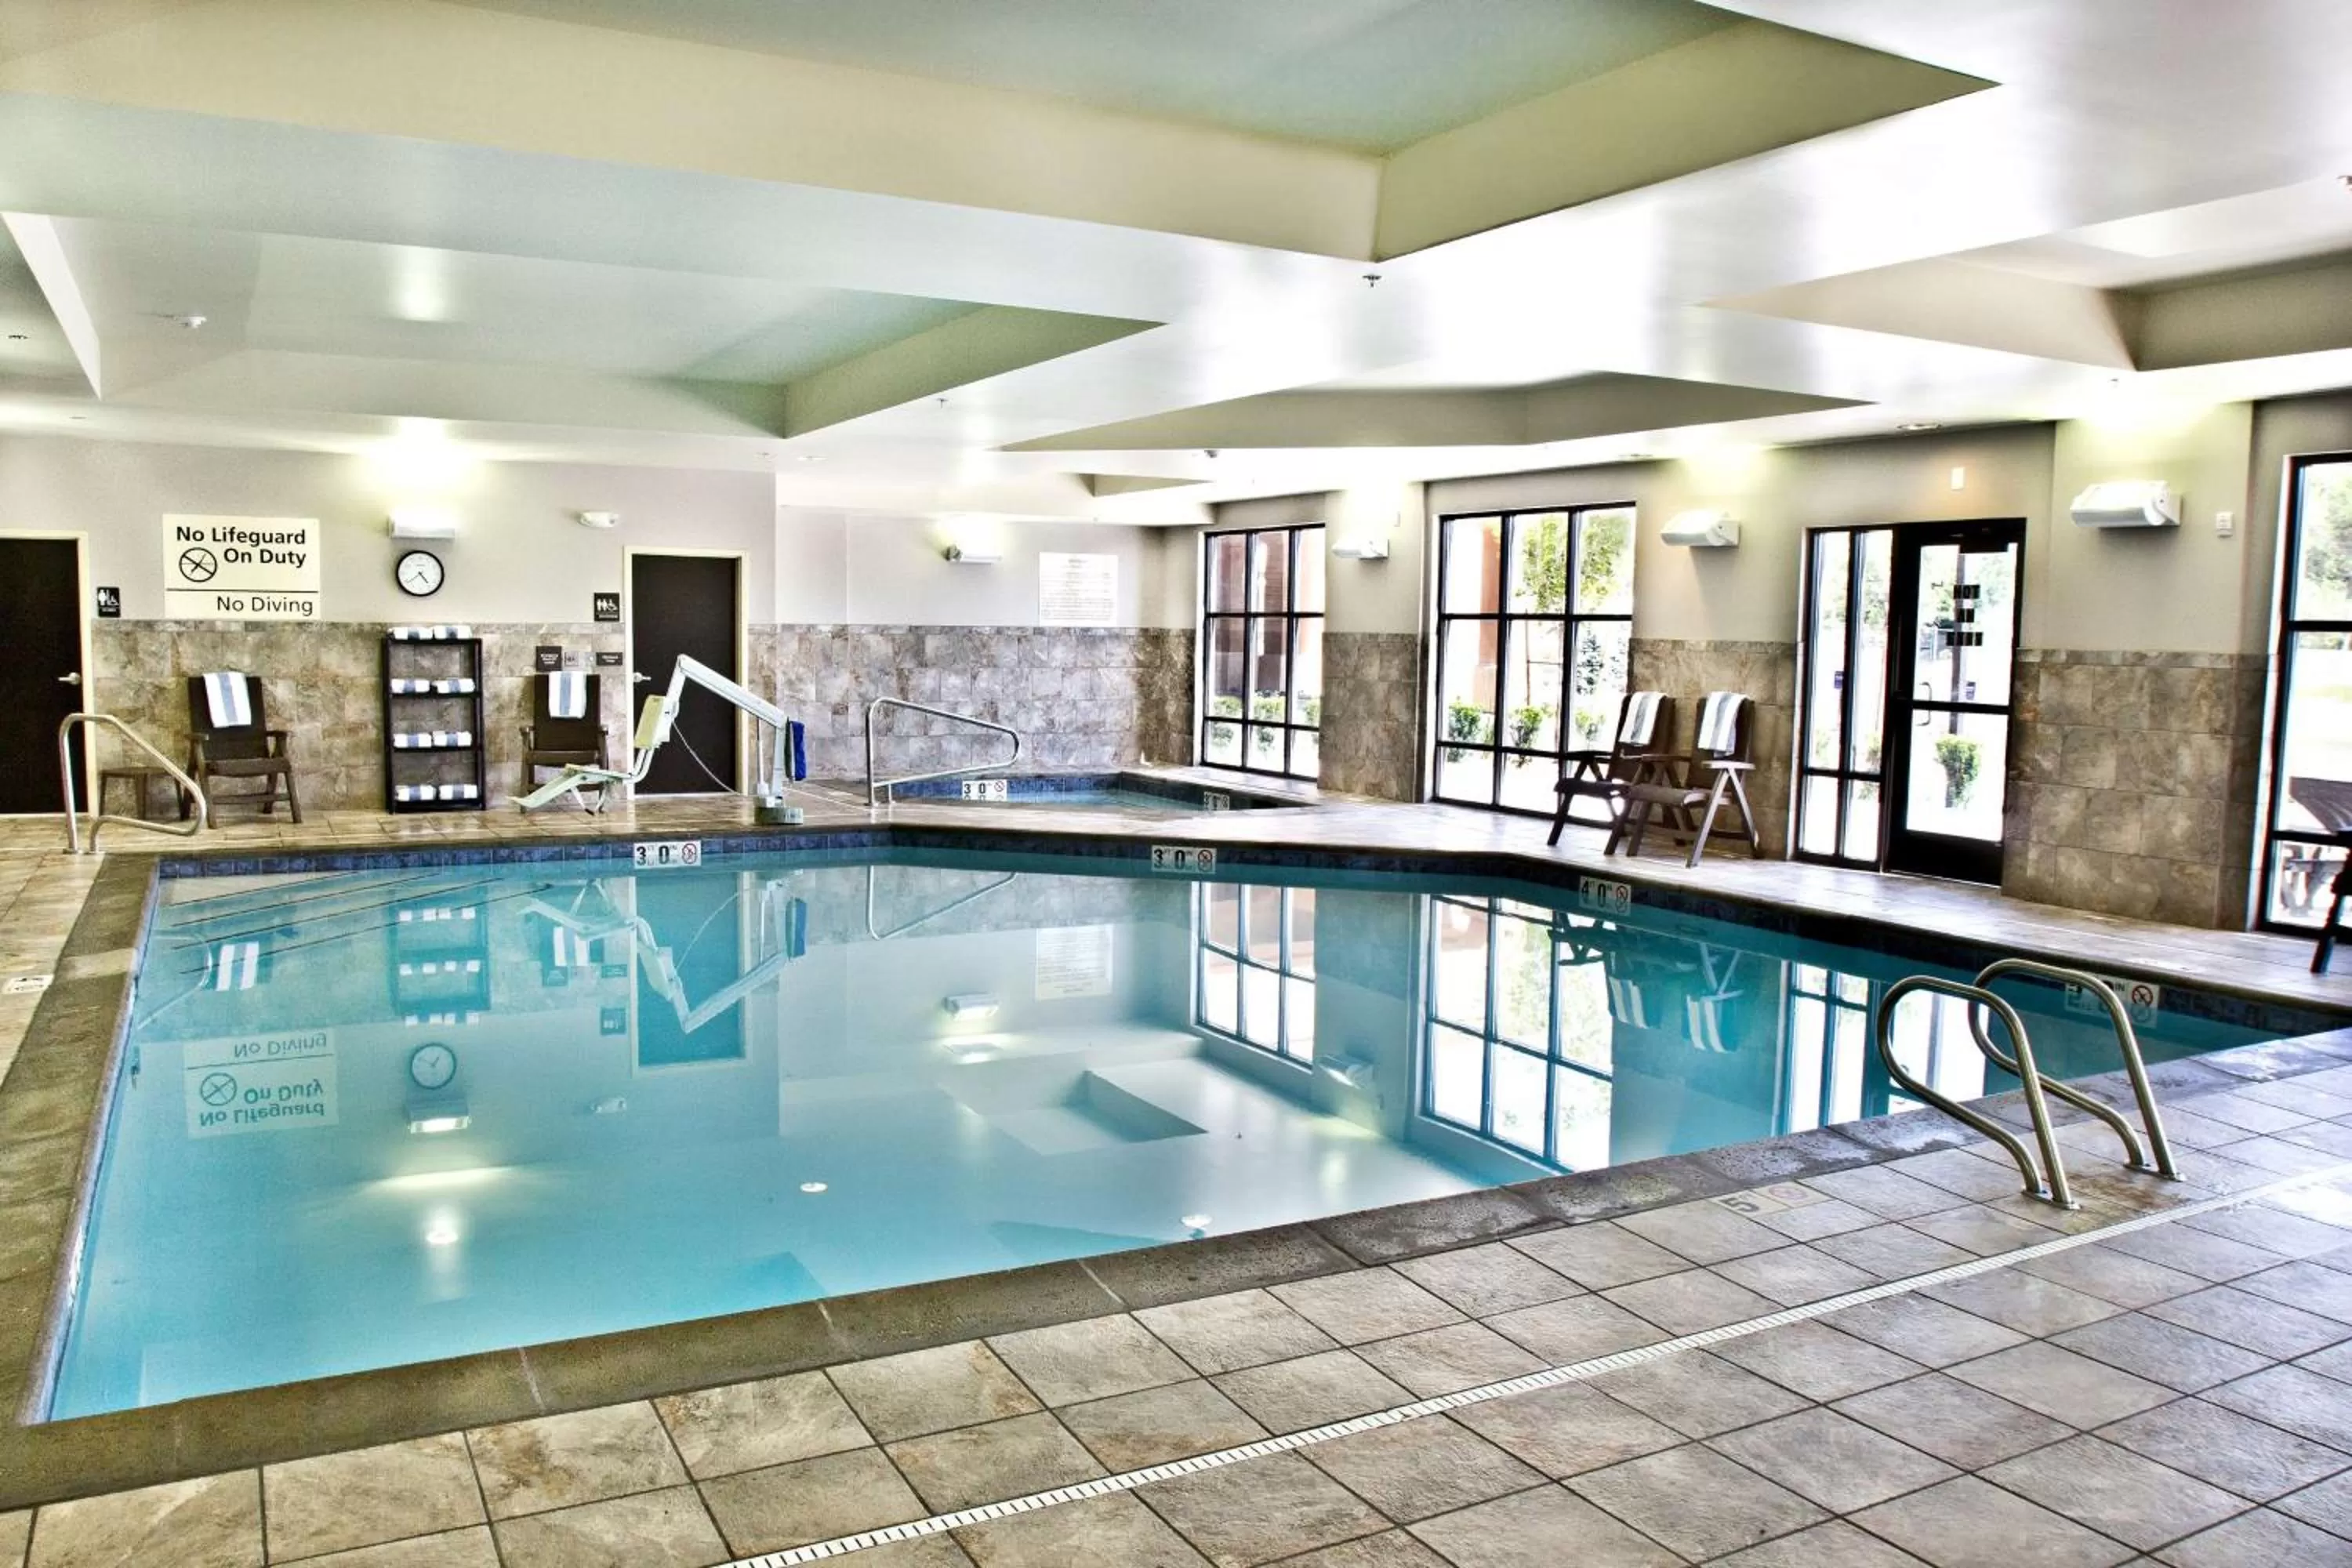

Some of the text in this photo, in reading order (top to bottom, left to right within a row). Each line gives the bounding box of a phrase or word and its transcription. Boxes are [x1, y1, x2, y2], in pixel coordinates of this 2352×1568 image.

[176, 527, 306, 547] No Lifeguard
[223, 548, 307, 568] On Duty
[217, 597, 313, 617] No Diving
[964, 783, 985, 794] 3 0
[637, 846, 647, 864] 3
[659, 845, 670, 864] 0
[1719, 1197, 1760, 1212] 5
